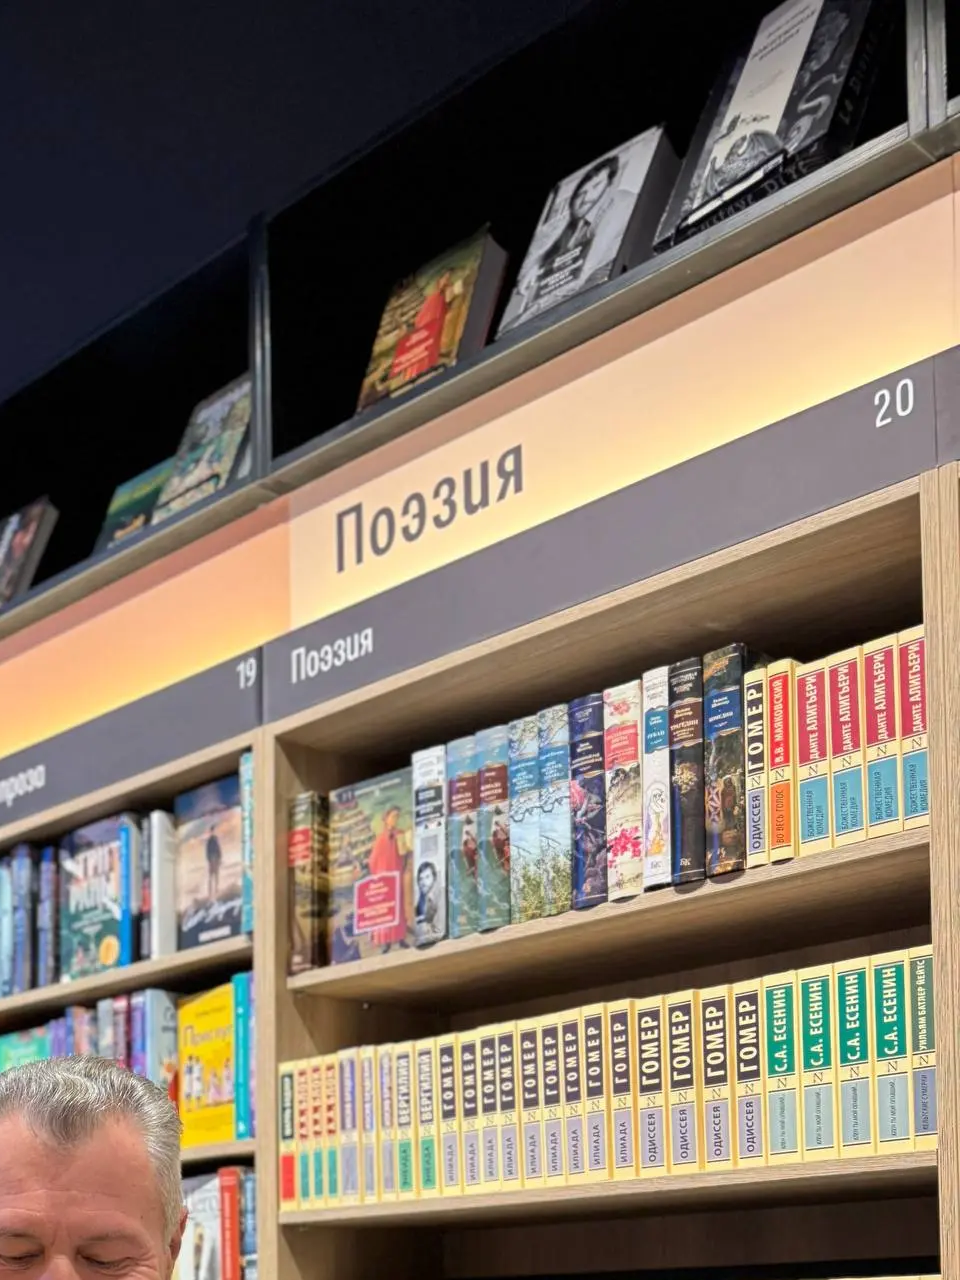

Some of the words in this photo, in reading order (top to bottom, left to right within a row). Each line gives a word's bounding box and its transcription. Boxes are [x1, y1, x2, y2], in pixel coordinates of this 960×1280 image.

[874, 378, 914, 428] 20
[334, 444, 525, 574] Поэзия
[236, 658, 256, 689] 19
[291, 627, 373, 684] Поэзия
[873, 651, 887, 709] АЛИГЬЕРИ
[908, 640, 922, 701] АЛИГЬЕРИ
[772, 678, 784, 743] МАЯКОВСКИЙ
[806, 675, 820, 730] АЛИГЬЕРИ
[838, 665, 852, 719] АЛИГЬЕРИ
[913, 703, 923, 732] ДАНТЕ
[748, 689, 763, 776] ГОМЕР
[774, 744, 784, 763] В.В.
[810, 729, 820, 760] ДАНТЕ
[843, 723, 853, 751] ДАНТЕ
[878, 712, 888, 741] ДАНТЕ
[752, 795, 761, 849] ОДИССЕЯ
[773, 988, 787, 1042] ЕСЕНИН
[809, 981, 823, 1036] ЕСЕНИН
[845, 974, 860, 1029] ЕСЕНИН
[882, 967, 897, 1023] ЕСЕНИН
[917, 986, 927, 1020] БАТЛЕР
[641, 1016, 660, 1086] ГОМЕР
[671, 1010, 691, 1082] ГОМЕР
[705, 1006, 725, 1078] ГОМЕР
[738, 1000, 758, 1073] ГОМЕР
[775, 1046, 787, 1072] С.А.
[811, 1038, 823, 1066] С.А.
[847, 1032, 860, 1060] С.А.
[884, 1026, 898, 1055] С.А.
[918, 1022, 928, 1050] УИЛЬЯМ
[442, 1054, 454, 1112] ГОМЕР
[463, 1052, 475, 1109] ГОМЕР
[483, 1047, 495, 1104] ГОМЕР
[500, 1045, 513, 1102] ГОМЕР
[620, 1121, 628, 1162] ИЛИАДА
[648, 1113, 656, 1162] ОДИССЕЯ
[680, 1108, 688, 1159] ОДИССЕЯ
[713, 1105, 721, 1157] ОДИССЕЯ
[746, 1101, 754, 1153] ОДИССЕЯ
